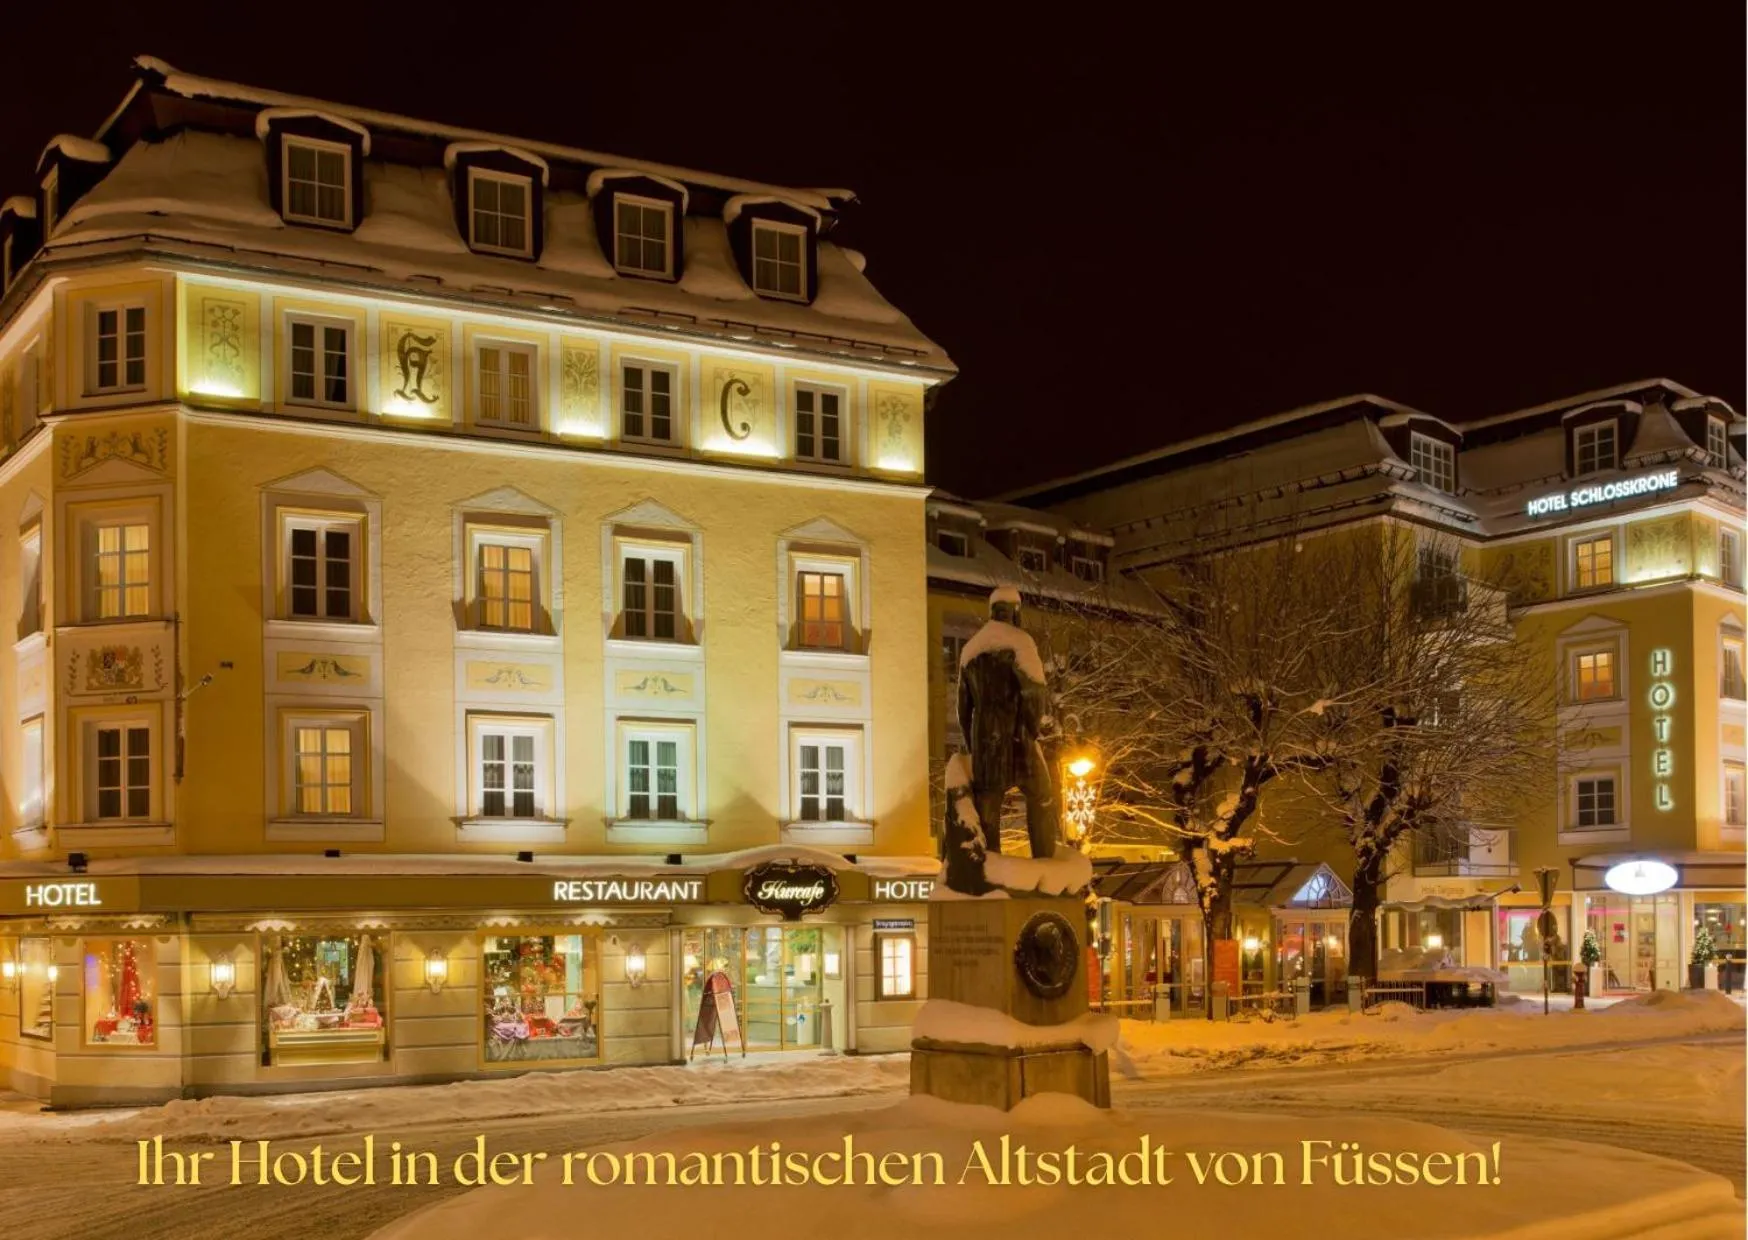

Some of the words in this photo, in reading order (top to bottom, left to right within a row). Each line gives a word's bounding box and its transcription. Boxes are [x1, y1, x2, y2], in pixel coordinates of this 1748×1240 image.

[1527, 493, 1568, 516] HOTEL
[1570, 470, 1679, 508] SCHLOSSKRONE
[1650, 650, 1673, 808] HOTEL
[25, 883, 102, 907] HOTEL
[553, 880, 702, 901] RESTAURANT
